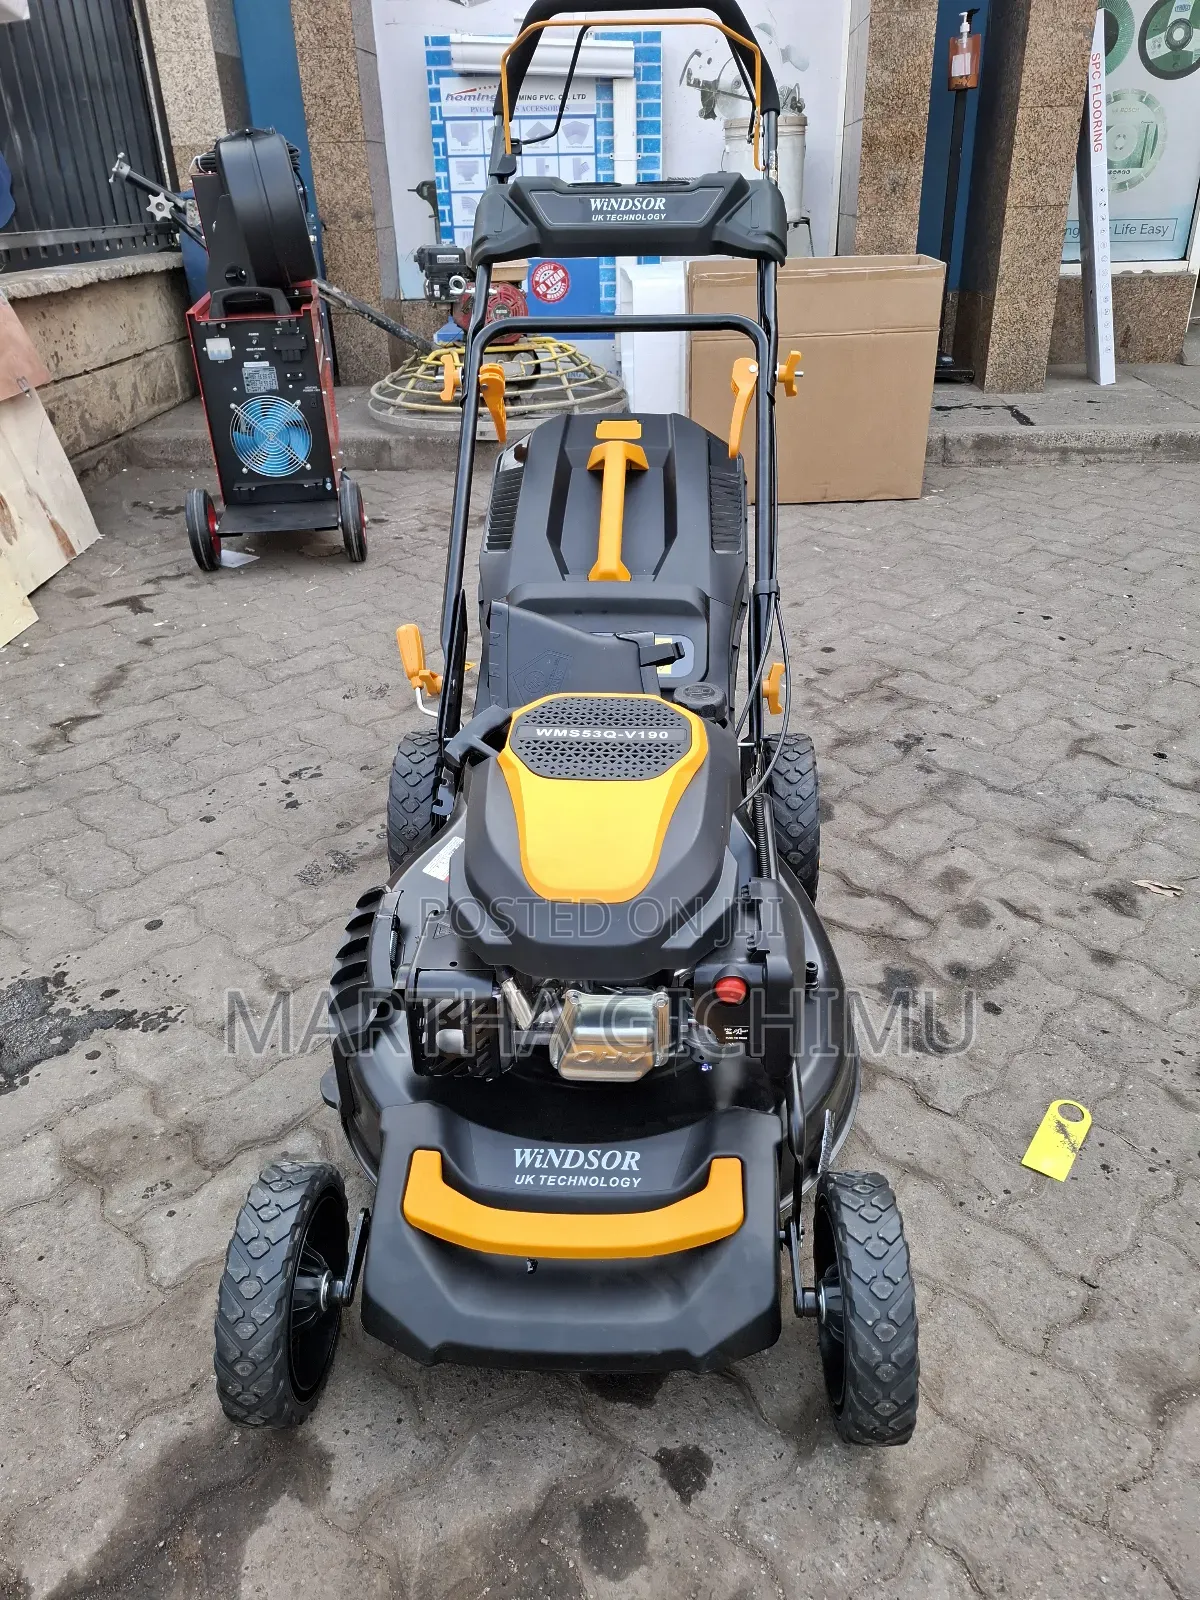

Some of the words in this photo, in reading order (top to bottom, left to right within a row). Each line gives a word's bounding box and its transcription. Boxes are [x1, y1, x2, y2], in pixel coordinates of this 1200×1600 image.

[1091, 52, 1101, 80] SPC
[1092, 84, 1103, 153] FLOORING
[1114, 224, 1137, 235] Life
[1140, 224, 1170, 237] Easy
[536, 284, 548, 294] 10
[545, 270, 566, 286] YEAR
[536, 728, 669, 739] WMS53Q-V190
[514, 1174, 536, 1184] UK
[540, 1175, 642, 1188] TECHNOLOGY
